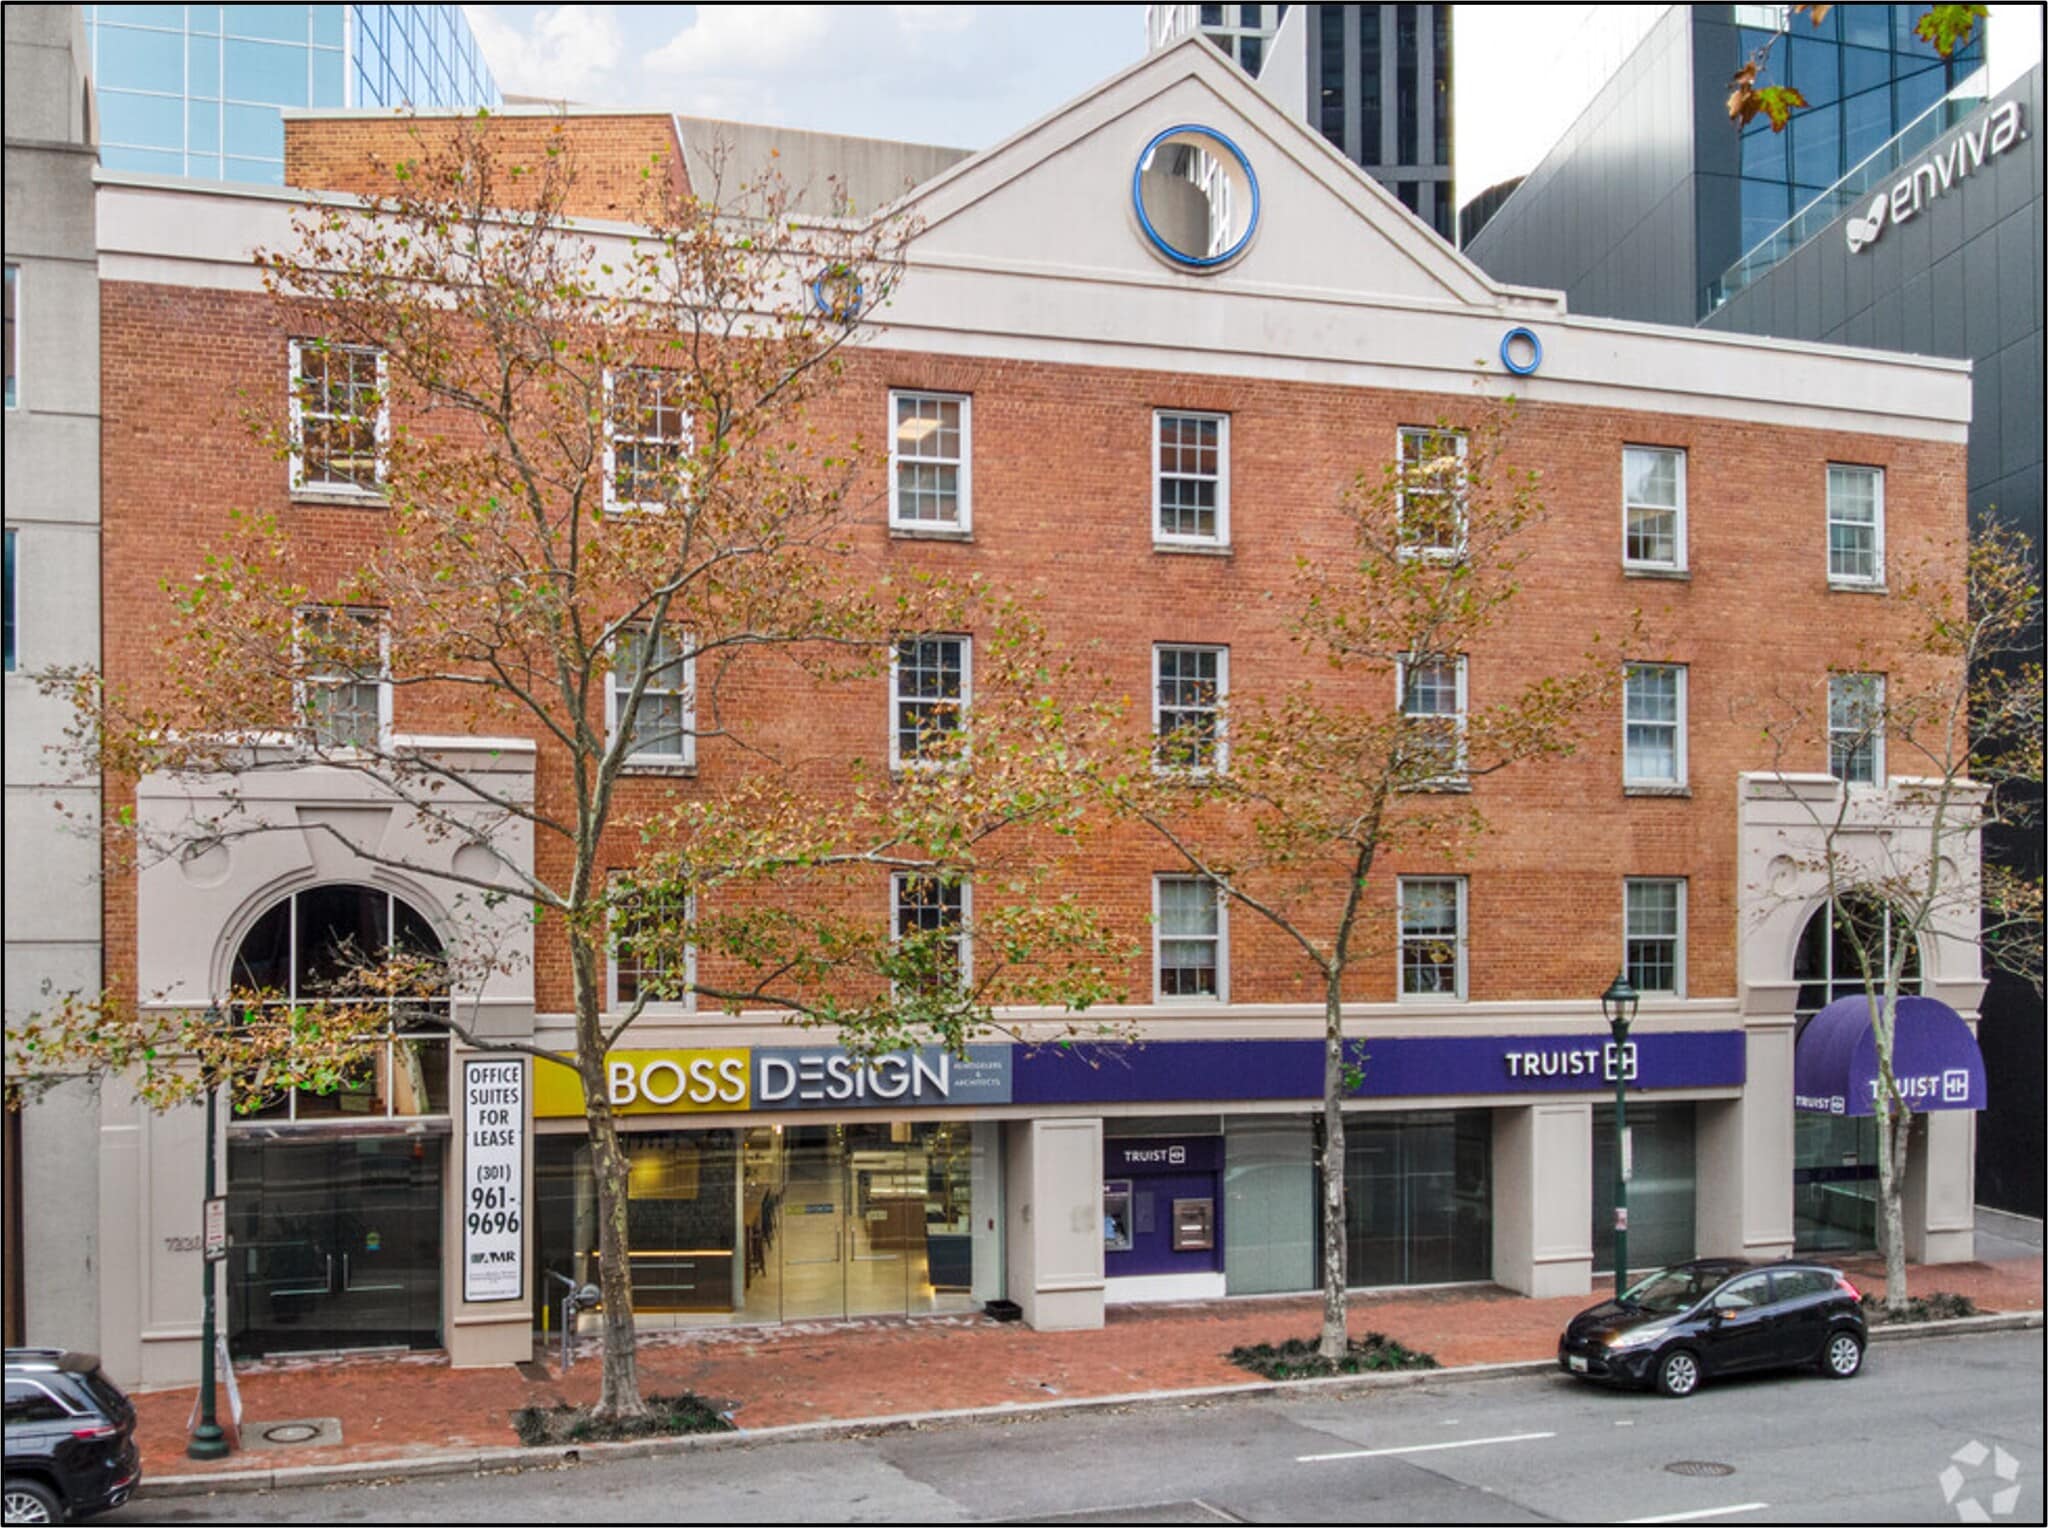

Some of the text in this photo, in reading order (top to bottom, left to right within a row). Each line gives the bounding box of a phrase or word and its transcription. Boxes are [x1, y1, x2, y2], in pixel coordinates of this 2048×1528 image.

[1505, 1051, 1600, 1077] TRUIST
[469, 1067, 519, 1084] OFFICE
[609, 1054, 949, 1104] BOSS DESIGN
[470, 1088, 519, 1105] SUITES
[1795, 1095, 1830, 1111] TRUIST
[479, 1109, 509, 1126] FOR
[473, 1130, 515, 1147] LEASE
[1124, 1149, 1167, 1163] TRUIST
[477, 1165, 511, 1184] (301)
[471, 1187, 515, 1210] 961-
[468, 1211, 519, 1236] 9696
